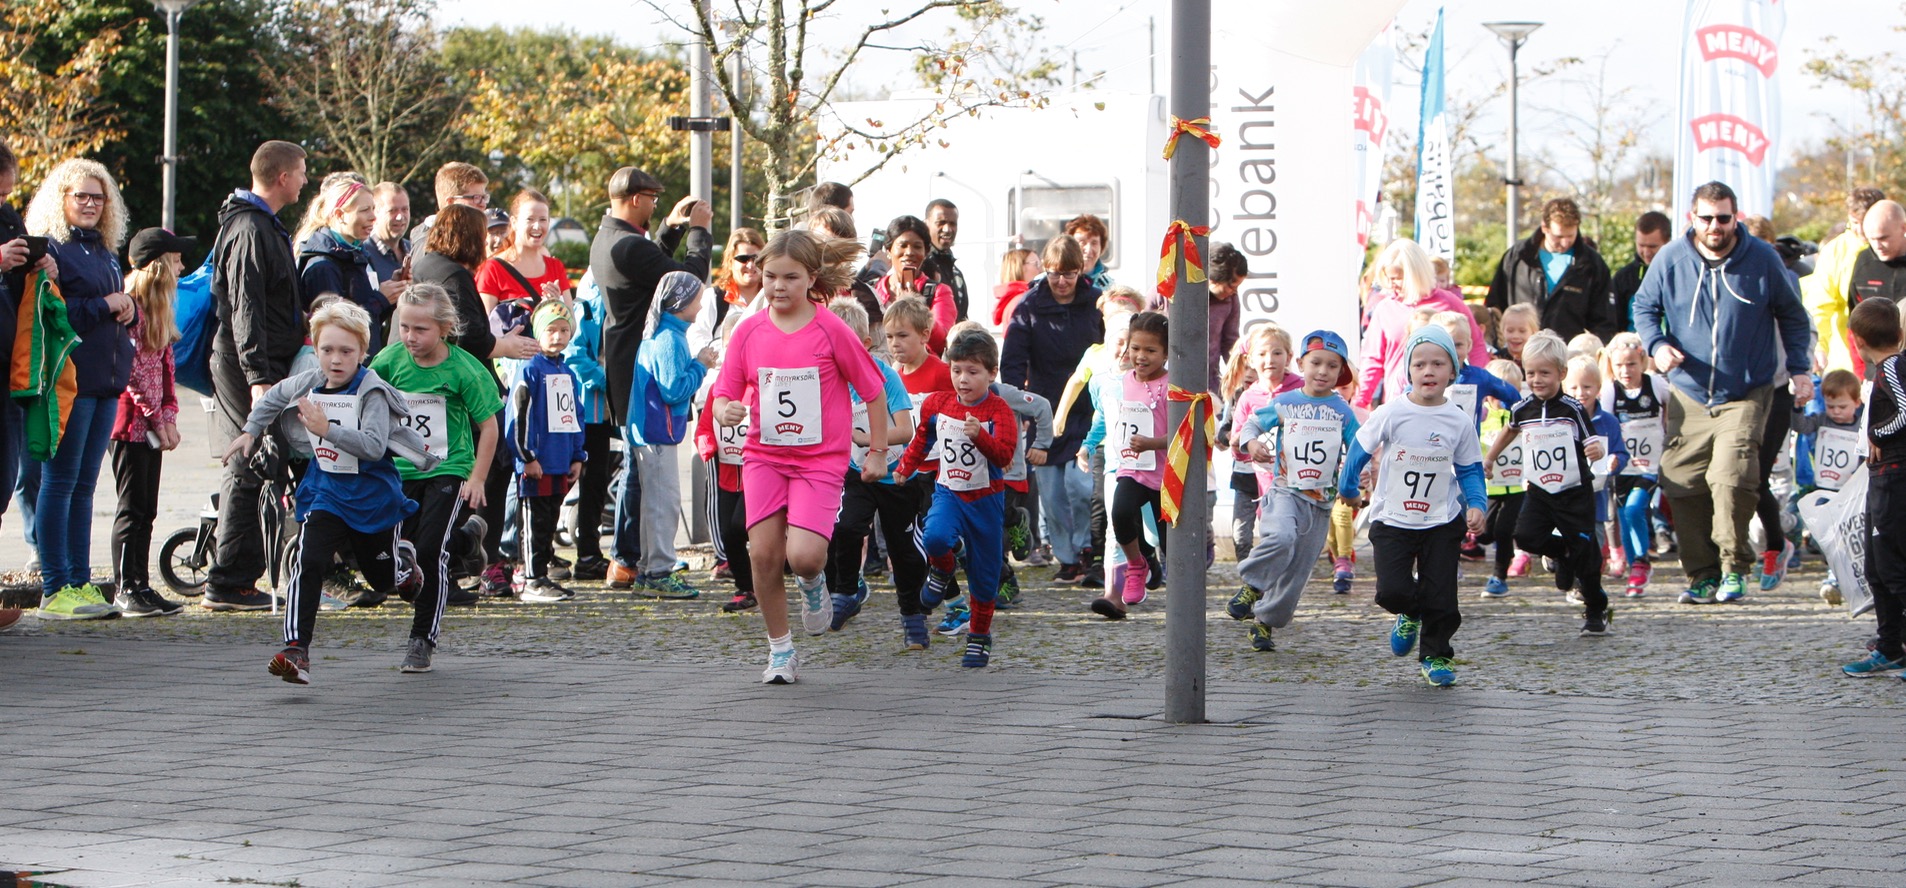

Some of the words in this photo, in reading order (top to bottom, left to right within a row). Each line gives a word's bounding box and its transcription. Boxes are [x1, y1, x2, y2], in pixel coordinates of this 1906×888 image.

[1704, 31, 1774, 66] MENY
[1698, 120, 1764, 154] MENY
[777, 390, 797, 418] 5
[778, 424, 801, 433] MENY
[317, 449, 337, 460] MENY
[944, 438, 976, 466] 58
[1294, 440, 1327, 465] 45
[1531, 446, 1567, 471] 109
[1625, 436, 1652, 458] 96
[1819, 444, 1849, 469] 130
[1403, 470, 1437, 499] 97
[1541, 475, 1562, 484] MENY
[1405, 502, 1428, 511] MENY
